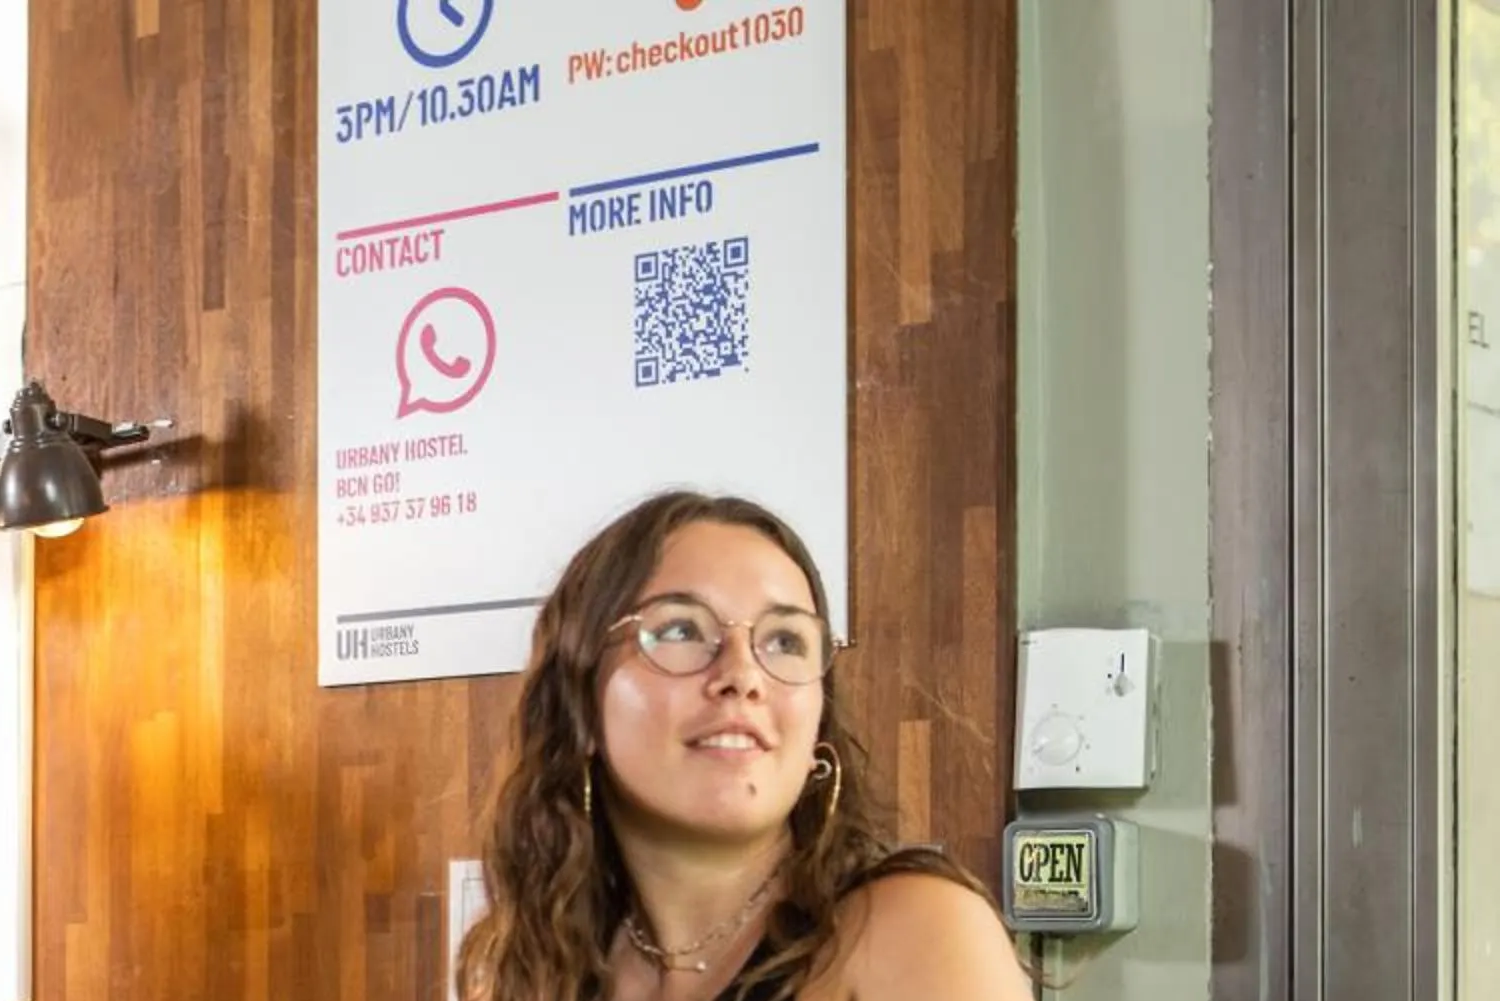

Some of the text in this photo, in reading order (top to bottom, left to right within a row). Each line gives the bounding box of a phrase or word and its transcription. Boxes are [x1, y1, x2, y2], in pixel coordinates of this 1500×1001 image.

[568, 6, 805, 84] PW:checkout1030
[336, 64, 541, 144] 3PM/10.30AM
[568, 180, 714, 236] MORE INFO
[336, 230, 445, 278] CONTACT
[336, 434, 468, 470] URBANY HOSTEL
[336, 471, 401, 499] BCN GO!
[337, 491, 477, 527] +34 937 37 96 18
[337, 628, 368, 660] UH
[371, 623, 415, 641] URBANY
[371, 639, 419, 658] HOSTELS
[1019, 842, 1084, 882] OPEN
